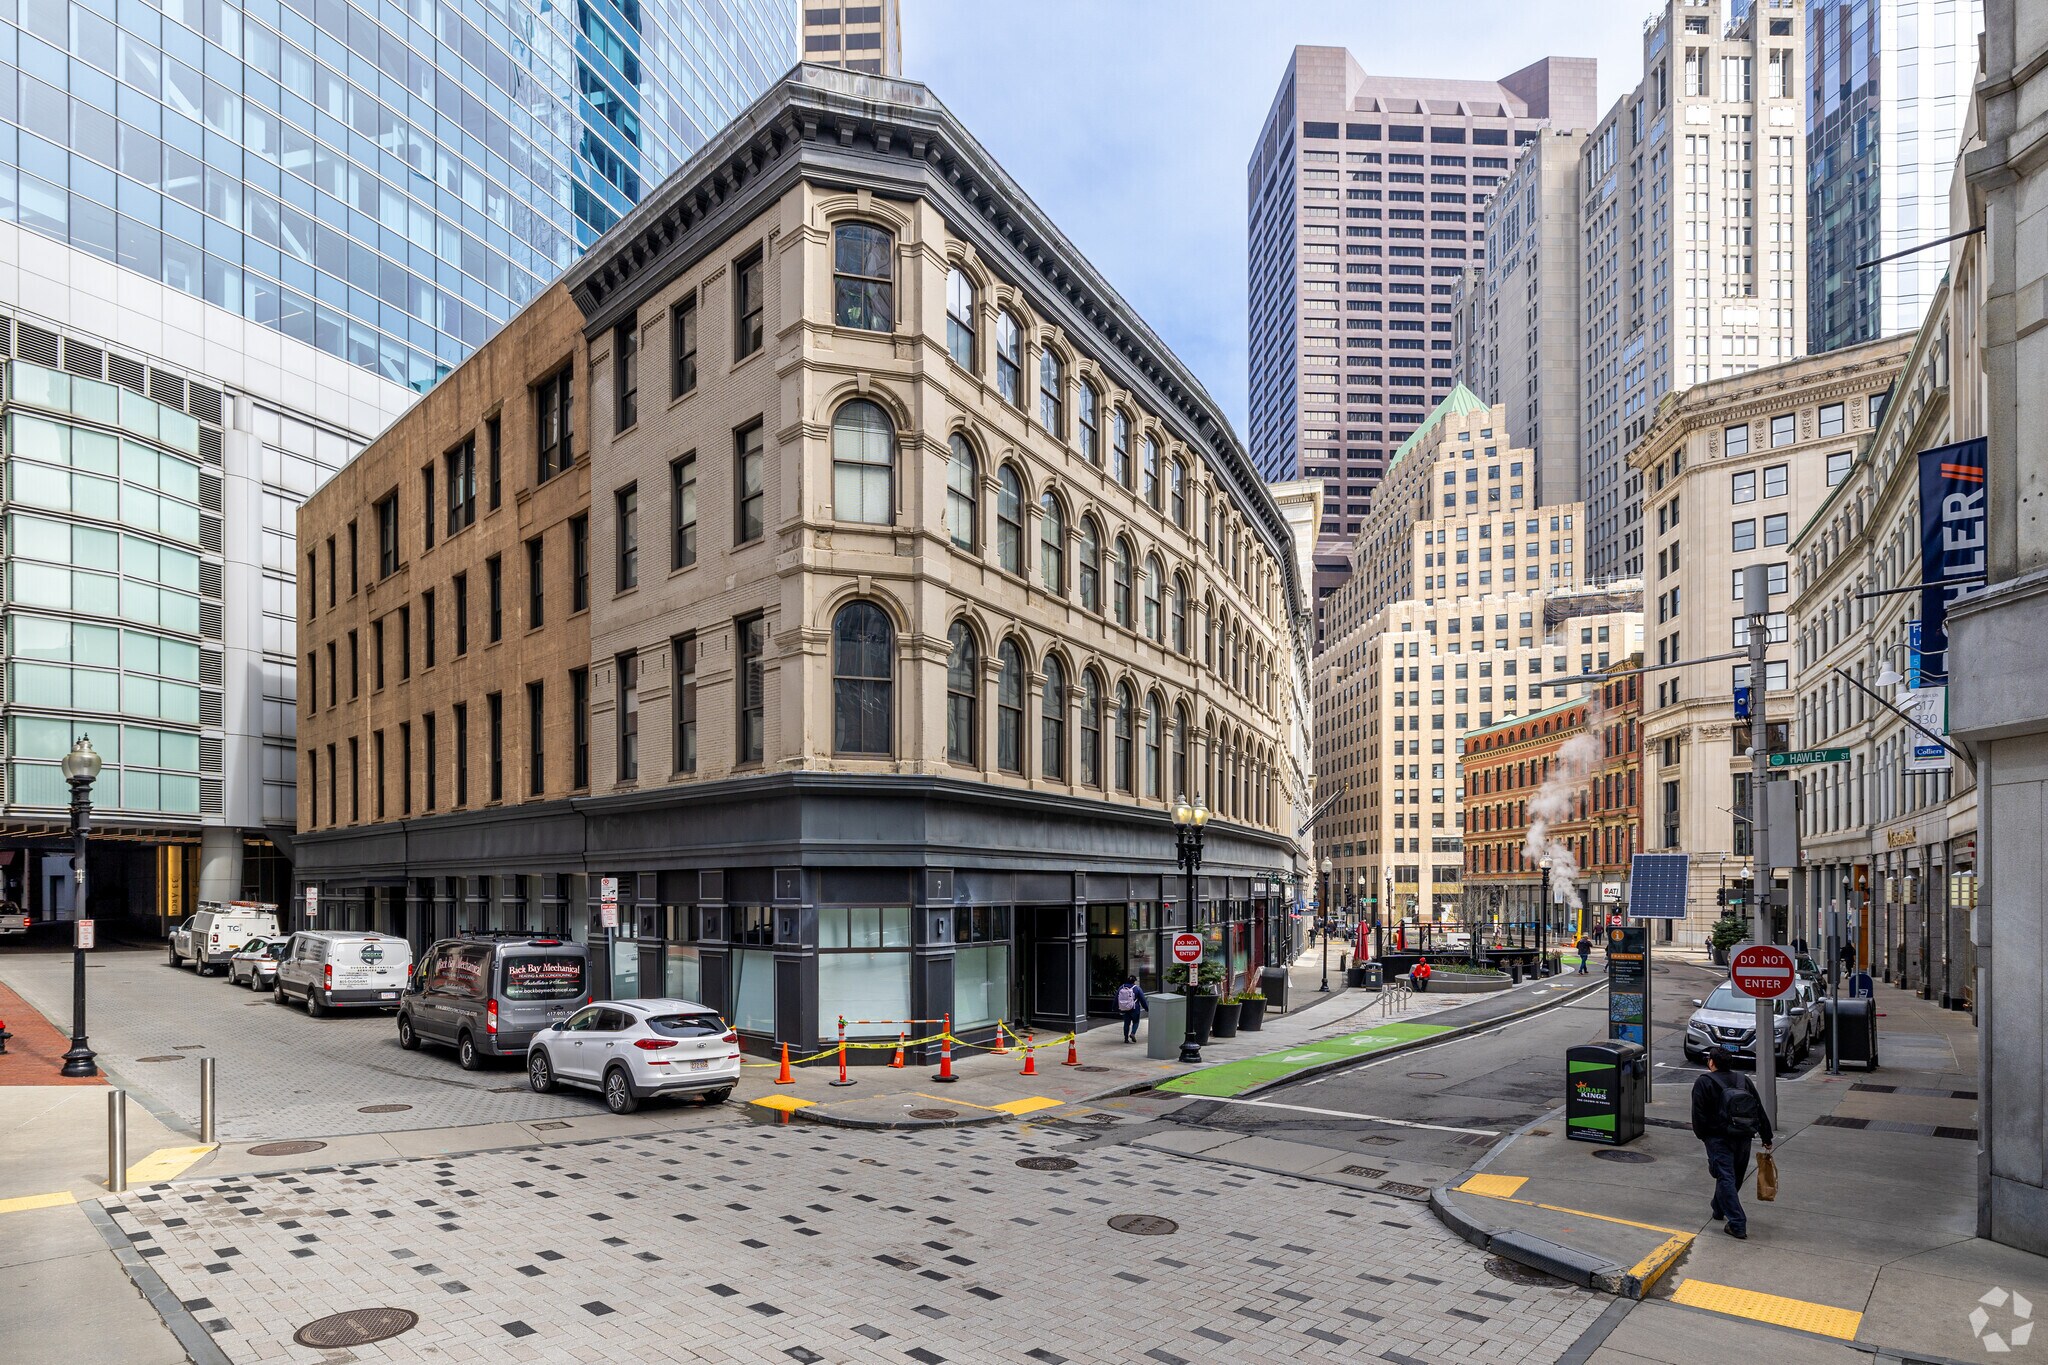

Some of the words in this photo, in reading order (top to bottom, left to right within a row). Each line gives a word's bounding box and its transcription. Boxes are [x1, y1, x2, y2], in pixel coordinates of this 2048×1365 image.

[1942, 487, 1985, 672] HLER
[1914, 700, 1935, 711] 617
[1914, 714, 1938, 724] 330
[1789, 751, 1828, 764] HAWLEY
[1840, 752, 1849, 760] ST
[1916, 748, 1942, 756] Colliers
[171, 878, 179, 889] 33
[171, 892, 179, 915] ARCH
[1740, 955, 1756, 964] DO
[1762, 955, 1785, 965] NOT
[508, 964, 527, 975] Back
[527, 963, 542, 973] Bay
[542, 962, 580, 974] Mechanical
[1744, 979, 1781, 989] ENTER
[1580, 1091, 1607, 1100] KINGS
